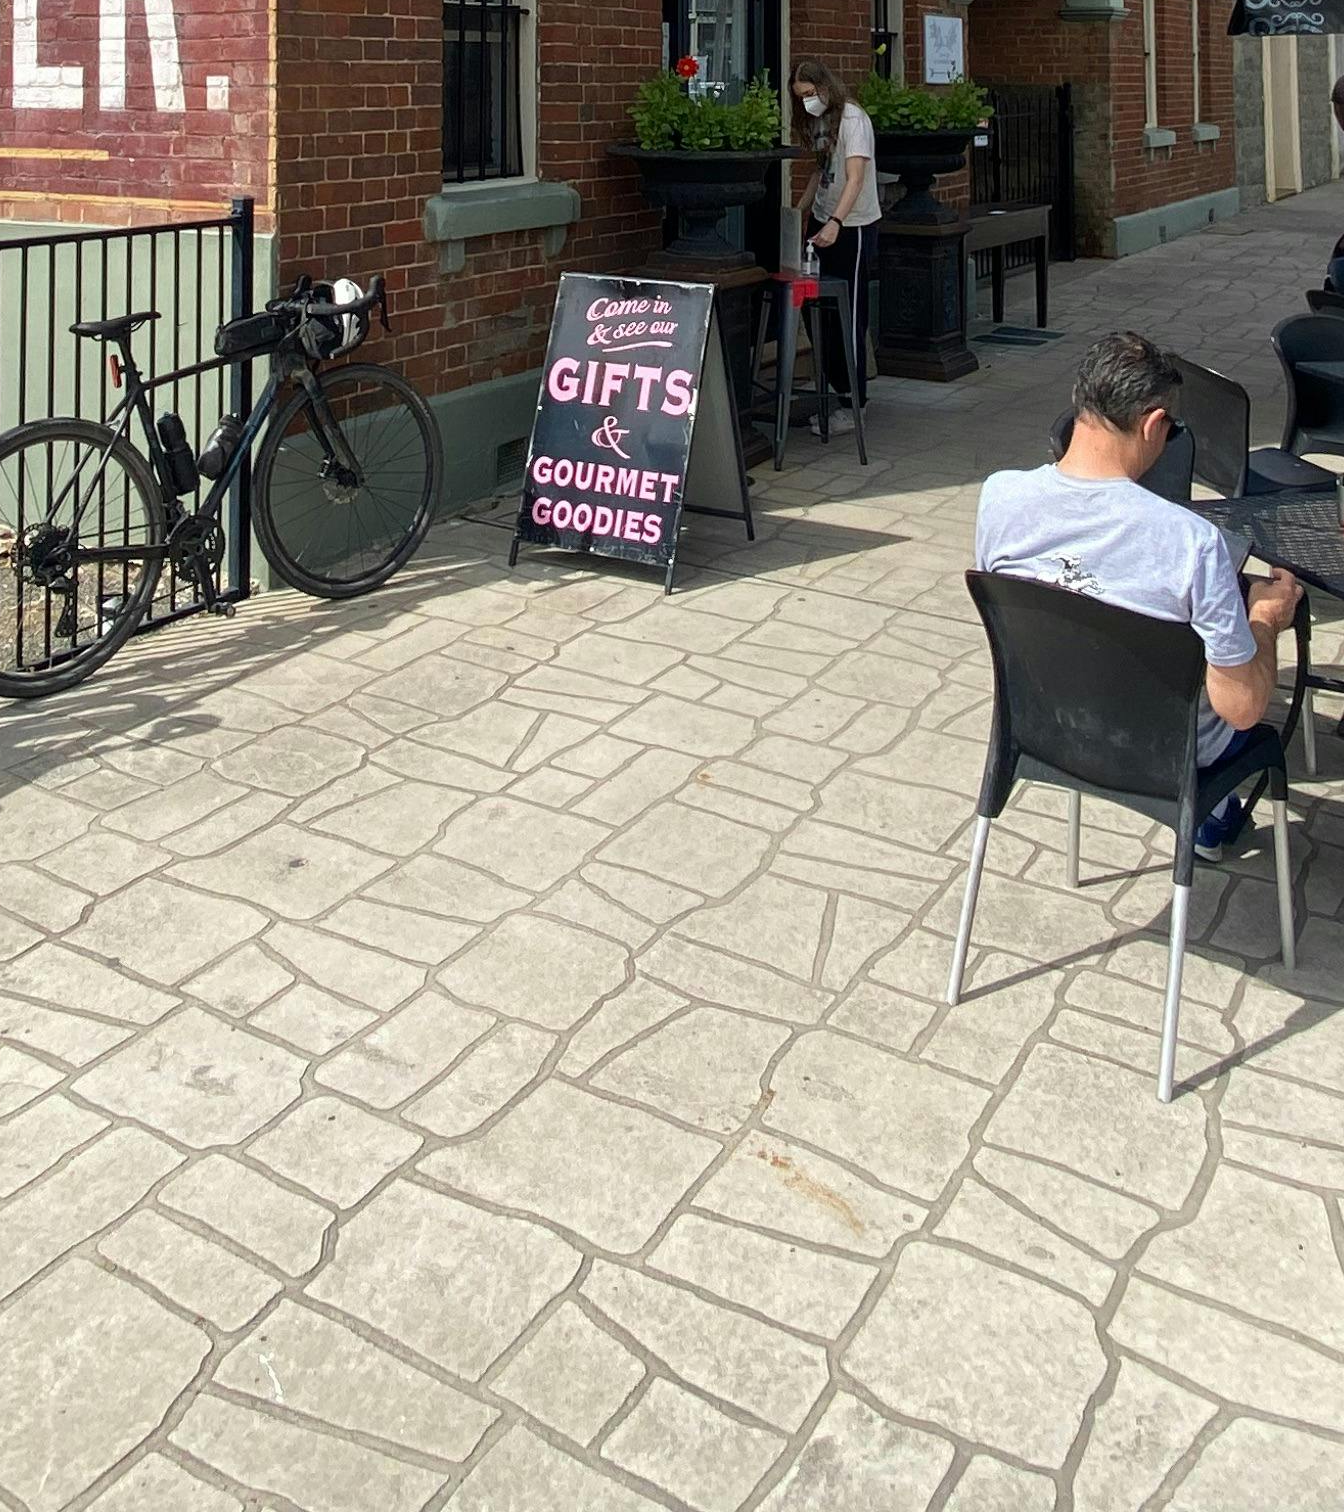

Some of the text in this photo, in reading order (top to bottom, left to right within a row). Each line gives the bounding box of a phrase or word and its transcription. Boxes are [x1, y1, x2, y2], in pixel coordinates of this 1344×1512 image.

[586, 294, 672, 322] Come in
[586, 320, 678, 346] & see our
[548, 357, 696, 417] GIFTS
[591, 416, 631, 459] &
[533, 455, 679, 503] GOURMET
[532, 496, 663, 544] GOODIES
